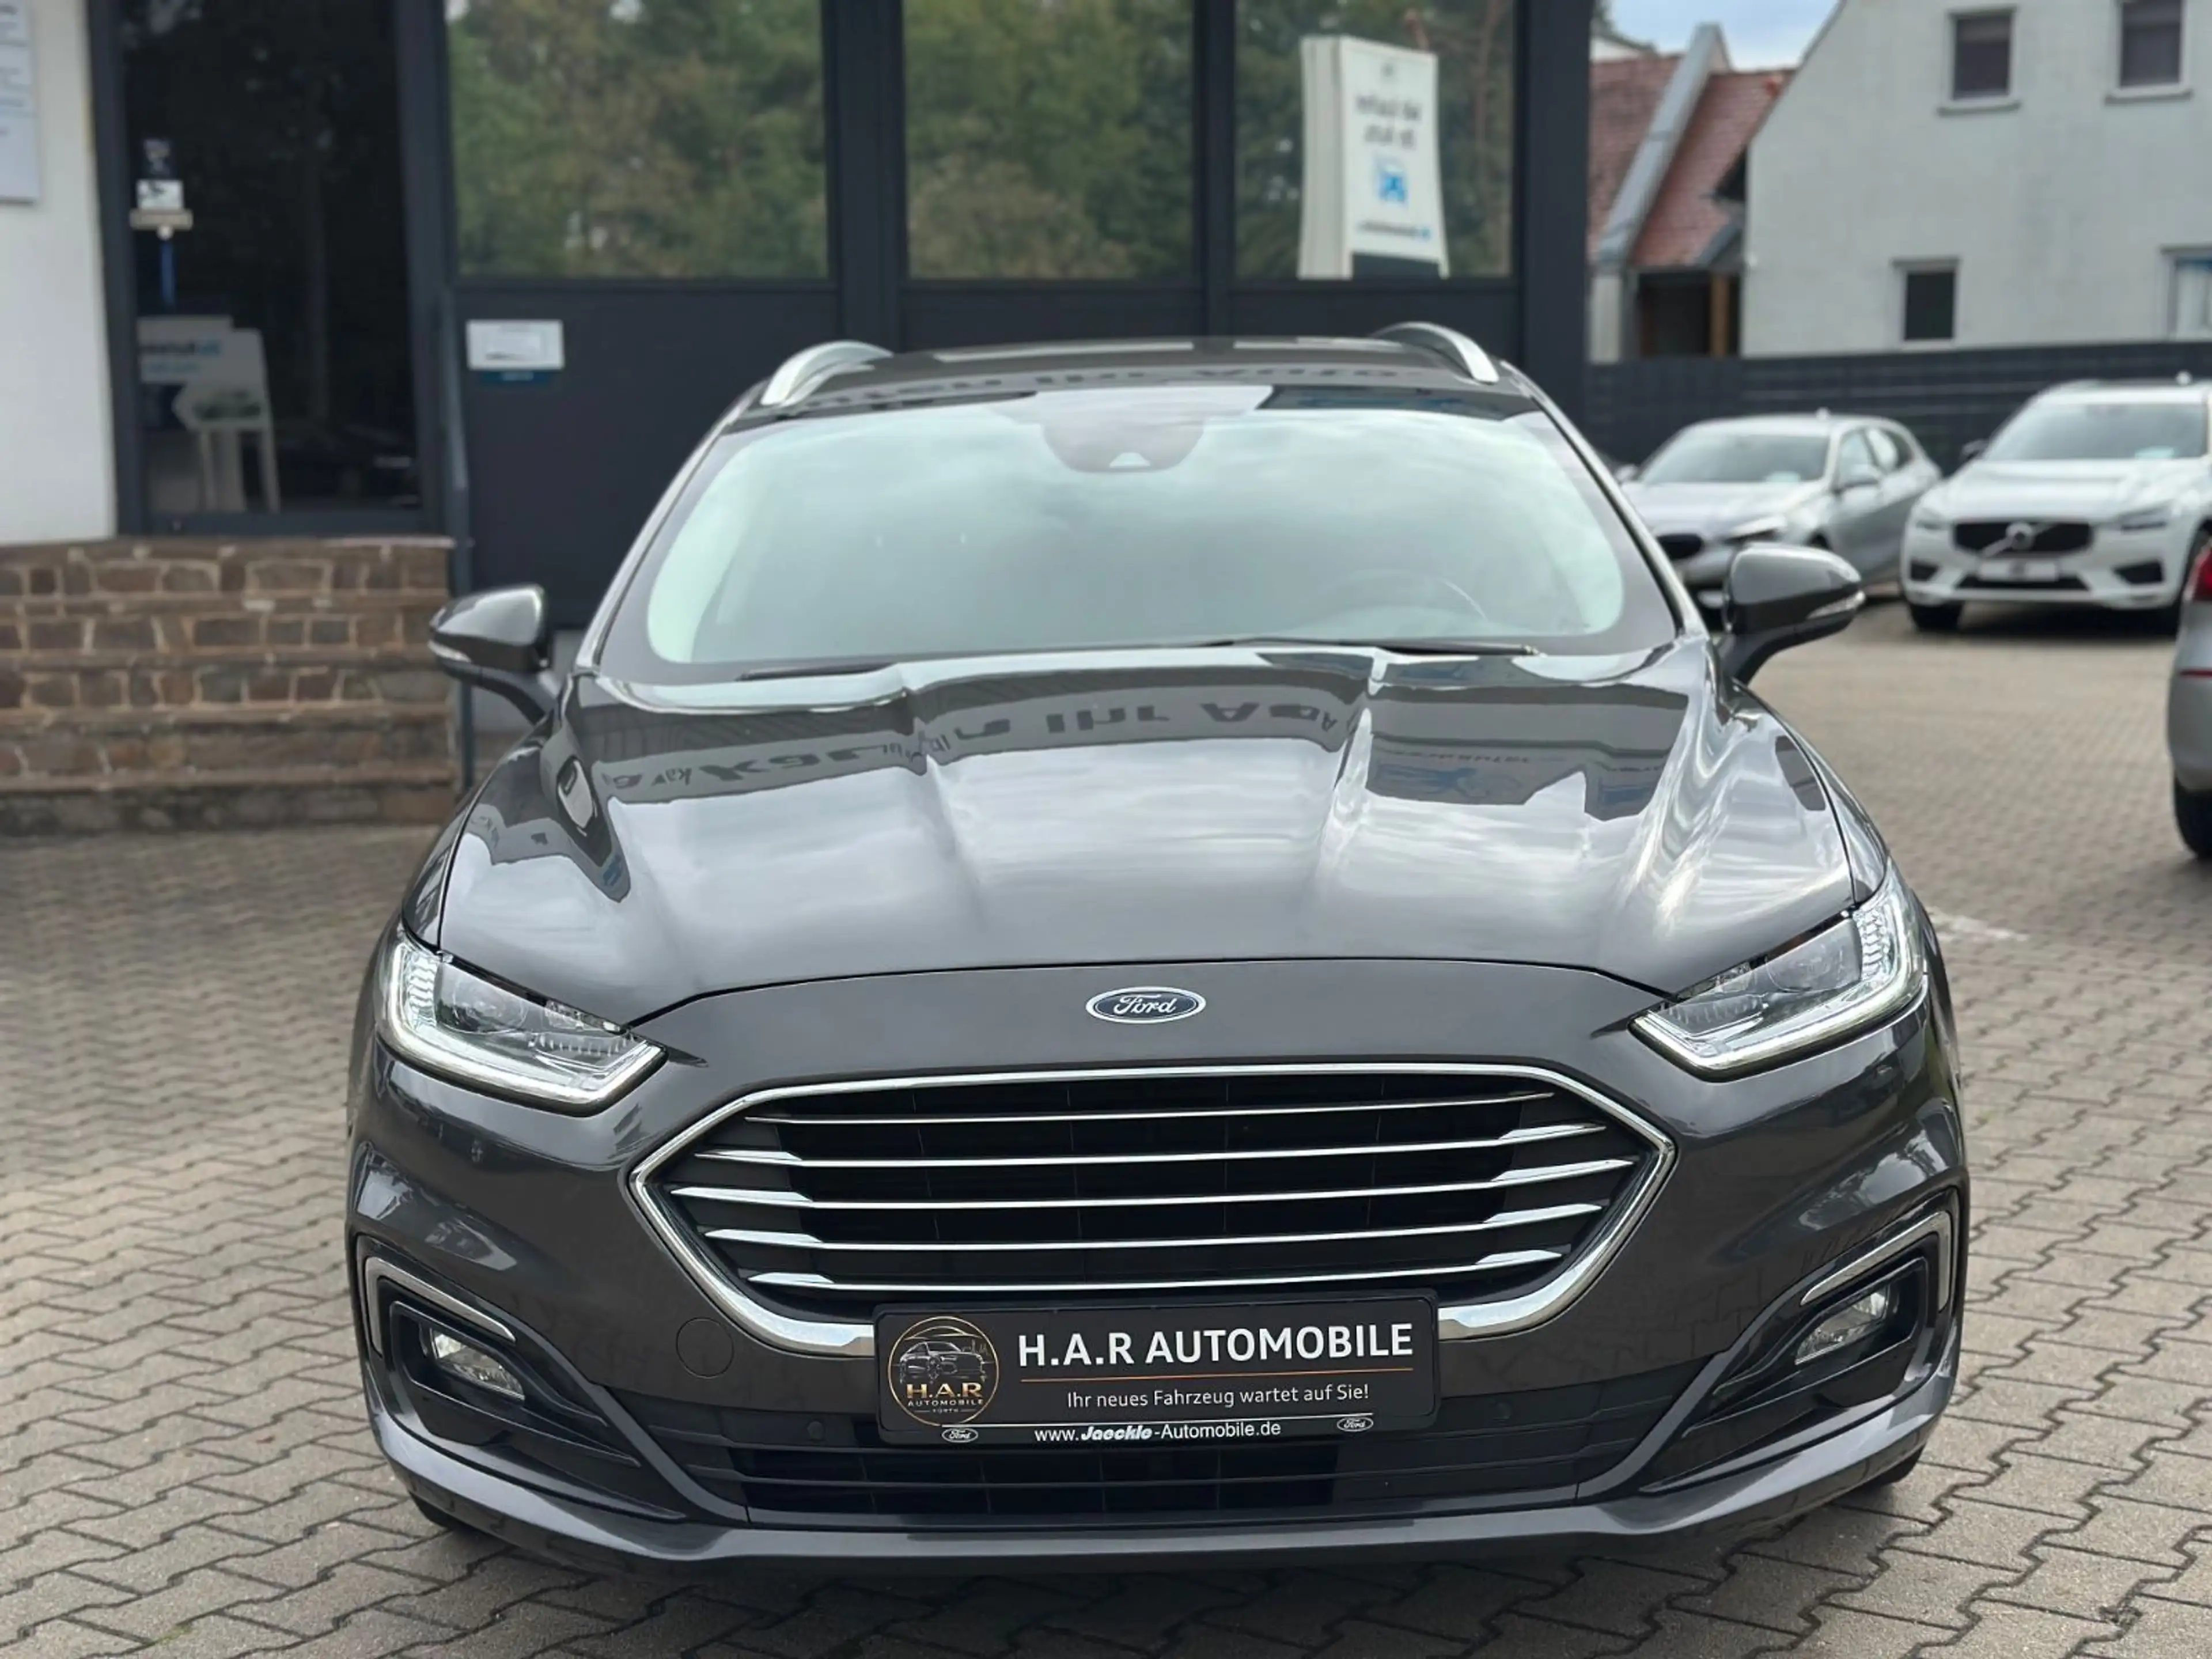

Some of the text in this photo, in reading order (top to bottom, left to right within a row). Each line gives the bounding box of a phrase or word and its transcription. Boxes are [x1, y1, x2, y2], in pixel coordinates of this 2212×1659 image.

[1113, 994, 1177, 1014] Ford
[1019, 1323, 1413, 1366] H.A.R AUTOMOBILE
[906, 1382, 983, 1399] H.A.R
[1067, 1384, 1369, 1408] Ihr neues Fahrzeug wartet auf Sie!
